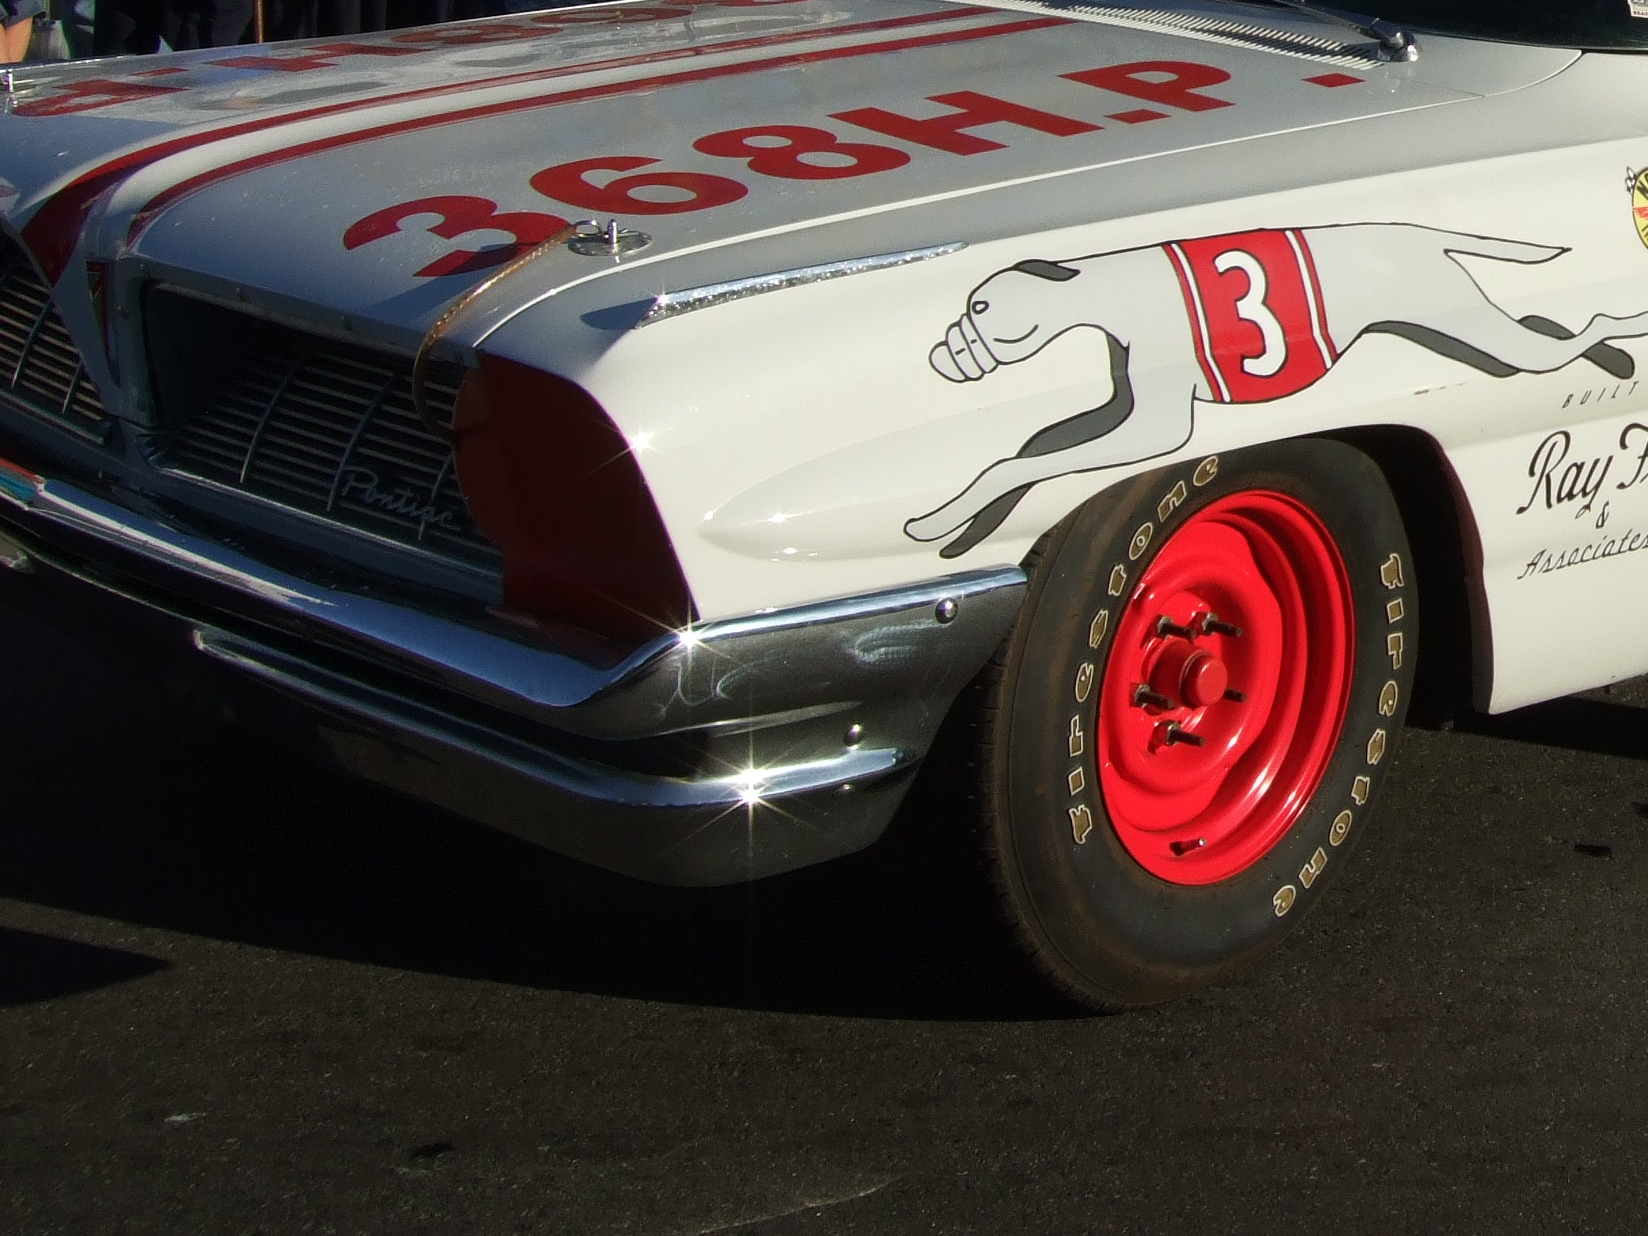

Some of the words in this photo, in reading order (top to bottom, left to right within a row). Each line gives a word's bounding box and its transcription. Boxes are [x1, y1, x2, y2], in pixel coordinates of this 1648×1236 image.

[1212, 249, 1289, 379] 3
[1562, 380, 1640, 409] BUILT
[1516, 429, 1614, 520] Ray
[1595, 501, 1610, 529] &
[1068, 455, 1219, 845] Firestone
[1272, 552, 1405, 918] Firestone
